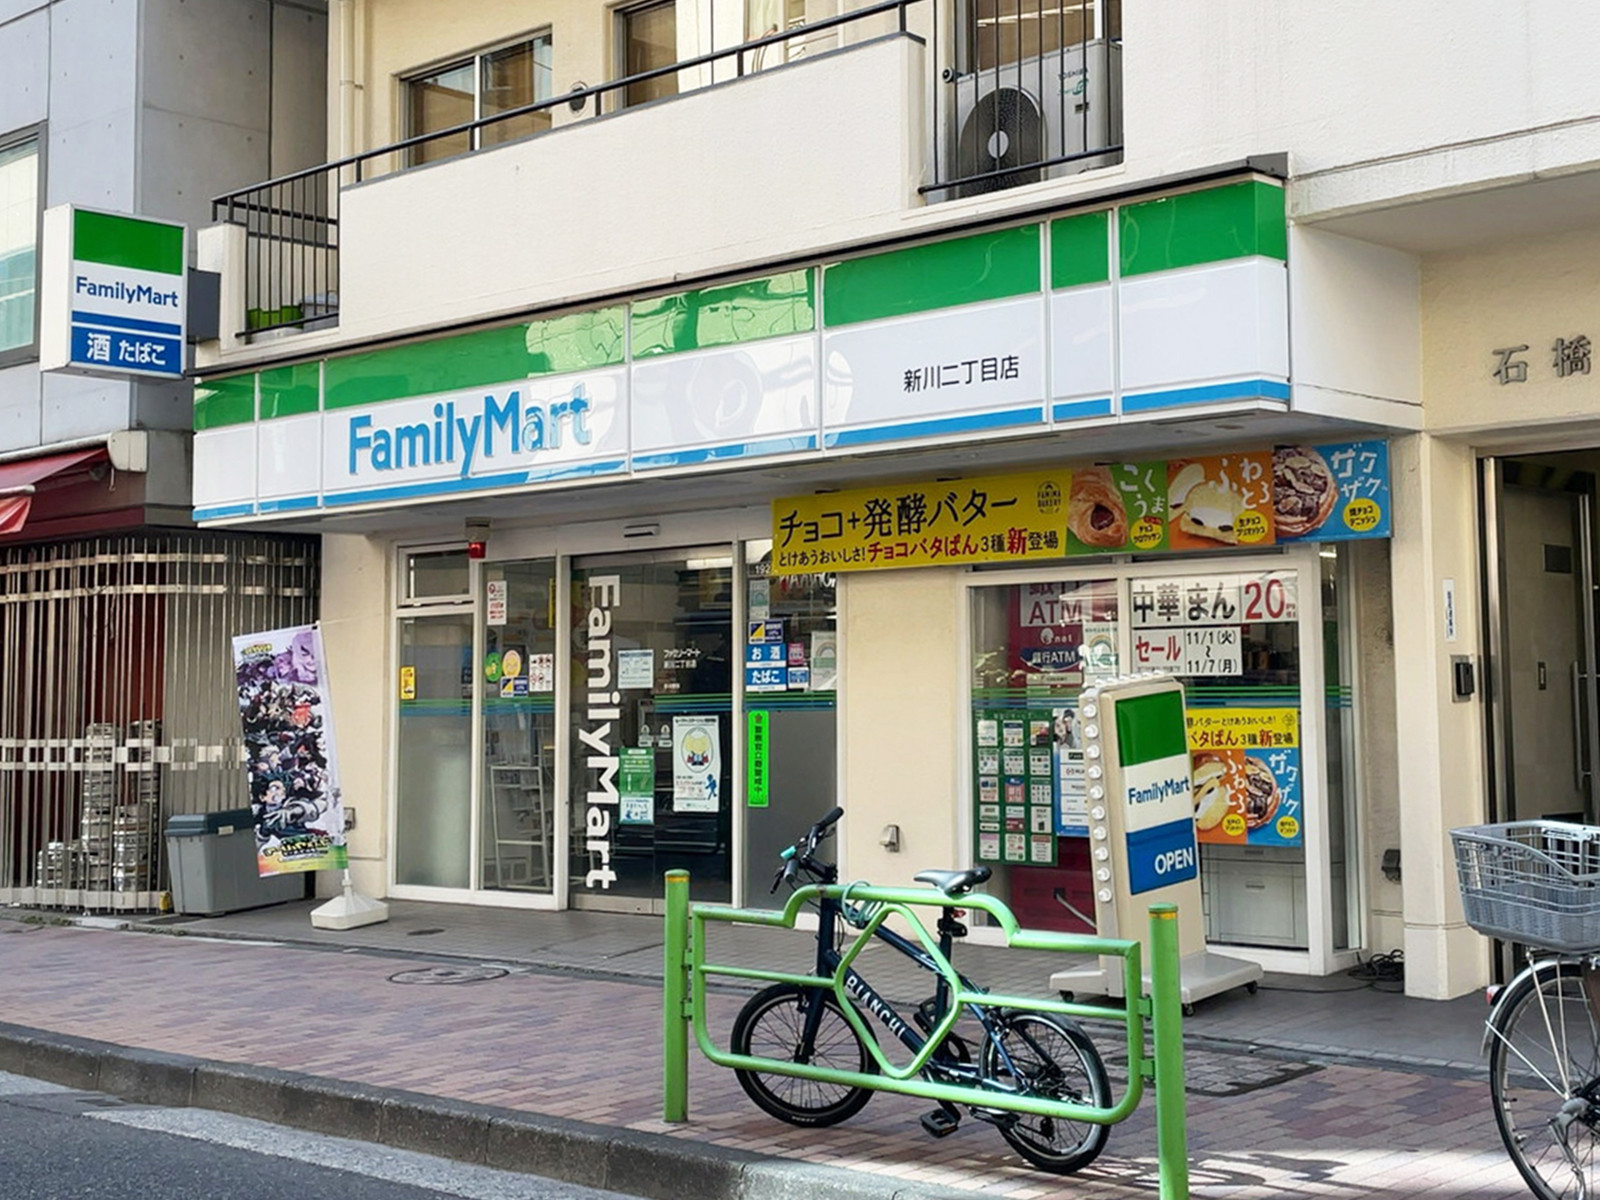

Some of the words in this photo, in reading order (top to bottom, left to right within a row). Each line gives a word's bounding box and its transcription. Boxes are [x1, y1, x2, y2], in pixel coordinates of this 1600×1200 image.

[76, 276, 178, 307] FamilyMart
[87, 332, 111, 362] 酒
[119, 339, 165, 365] たばこ
[904, 355, 1019, 393] 新川二丁目店
[349, 382, 591, 478] FamilyMart
[779, 489, 1017, 547] チョコ+発酵バター
[1029, 600, 1082, 624] ATM
[1133, 583, 1236, 623] 中華まん
[1245, 579, 1285, 619] 20
[1136, 635, 1181, 662] セール
[1187, 630, 1236, 645] 11/1(火)
[752, 670, 780, 684] たばこ
[1187, 658, 1237, 673] 11/7(月)
[579, 575, 621, 889] FamilyMart
[1128, 776, 1190, 805] FamilyMart
[1154, 847, 1194, 875] OPEN
